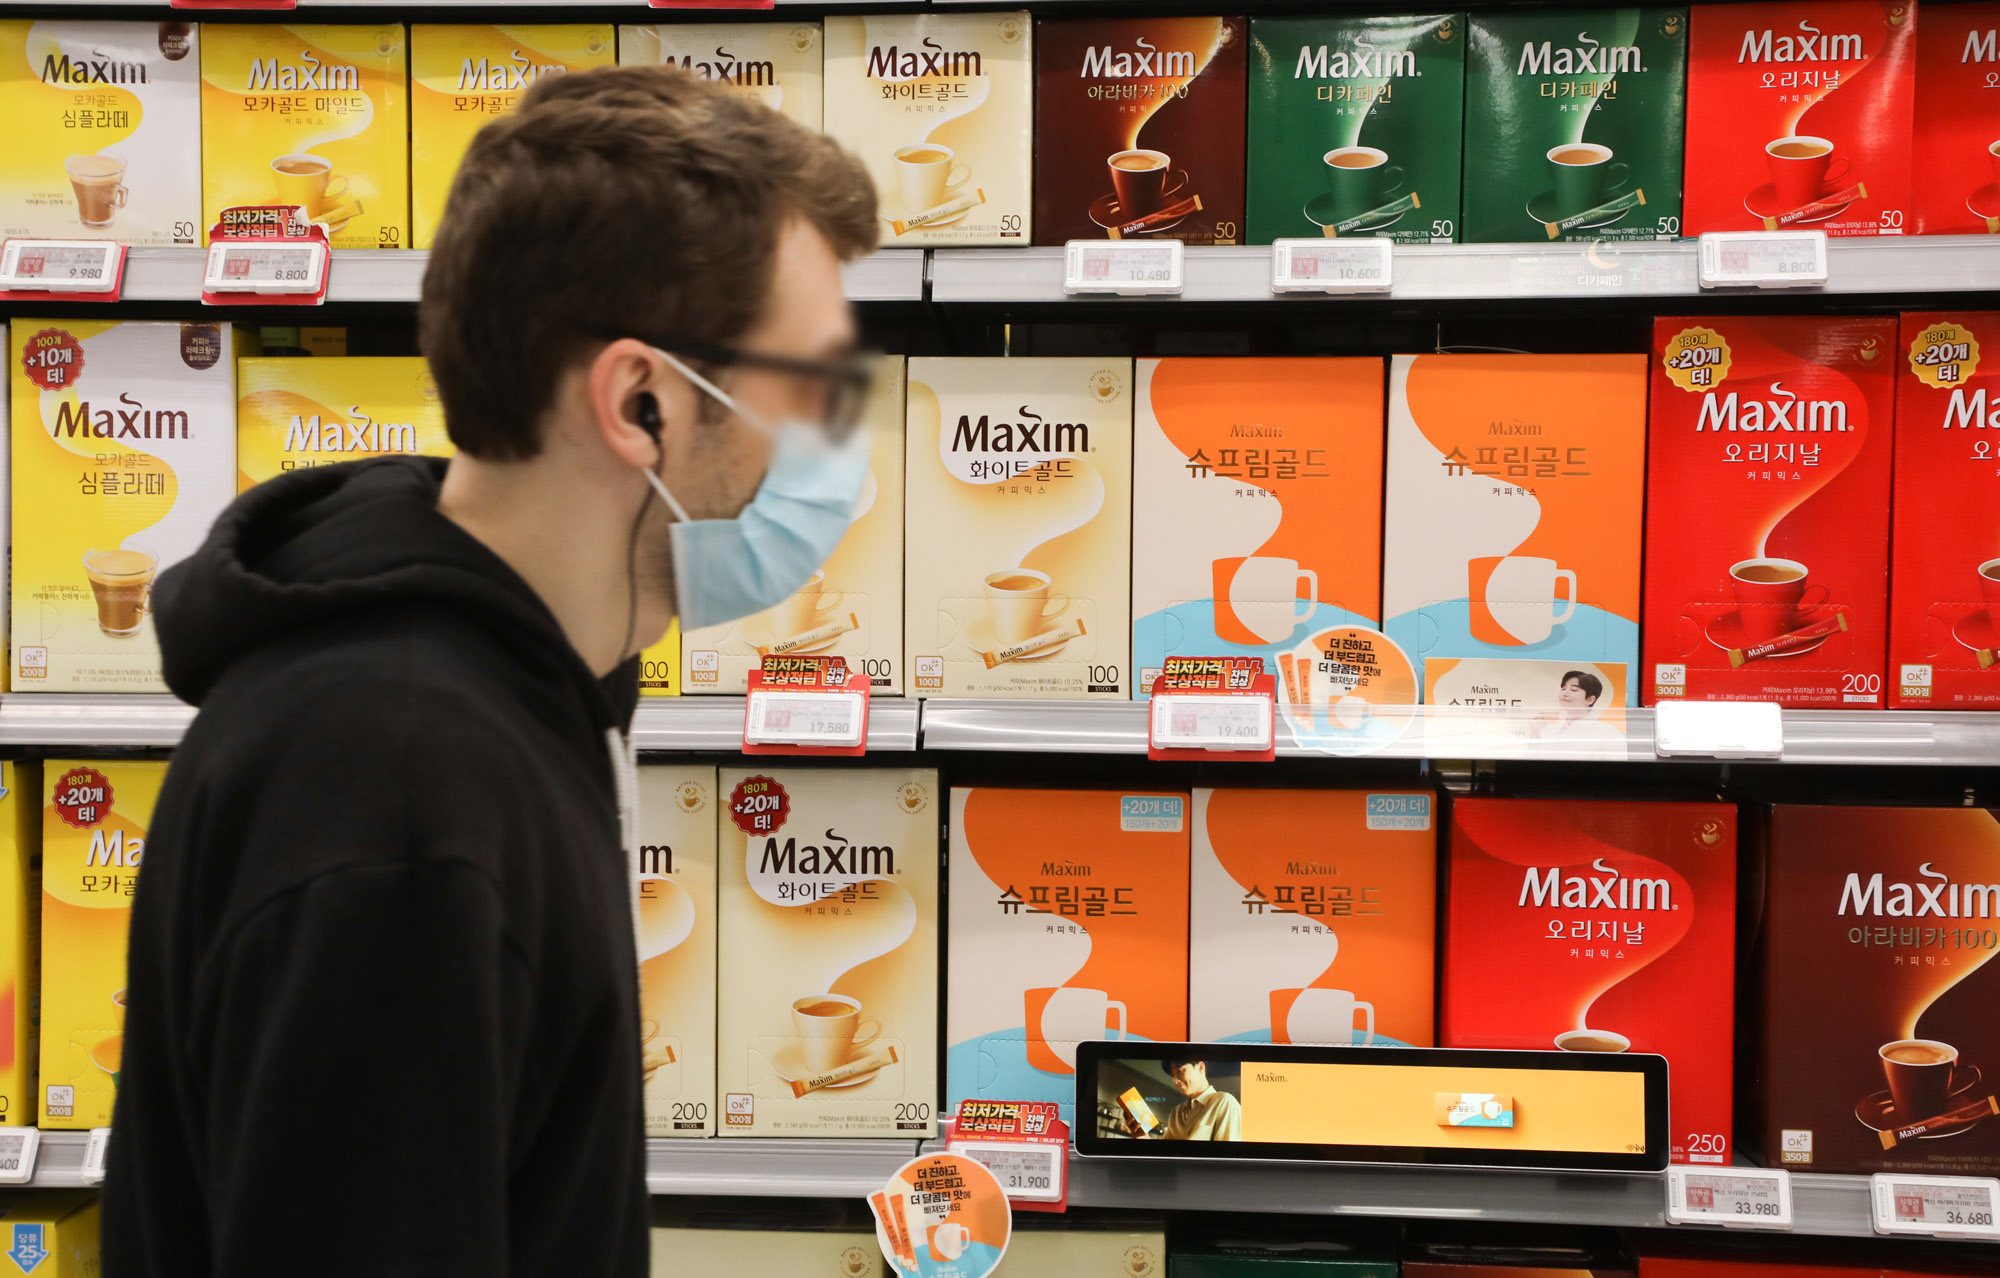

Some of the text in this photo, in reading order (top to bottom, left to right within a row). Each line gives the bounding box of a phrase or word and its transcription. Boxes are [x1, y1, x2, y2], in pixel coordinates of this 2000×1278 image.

[1738, 20, 1862, 62] Maxim
[867, 37, 981, 77] Maxim
[1081, 37, 1195, 77] Maxim
[1294, 36, 1416, 79] Maxim
[1517, 32, 1641, 75] Maxim
[42, 49, 147, 84] Maxim
[248, 51, 358, 90] Maxim
[1760, 70, 1841, 89] 오리지날
[882, 84, 968, 101] 화이트골드
[1317, 84, 1392, 104] 디카페인
[1541, 80, 1617, 99] 디카페인
[74, 95, 118, 107] 모카골드
[1780, 94, 1824, 102] 커피믹스
[243, 97, 365, 115] 모카골드 마일드
[62, 110, 129, 128] 심플라떼
[223, 209, 279, 224] 최저가격
[1001, 215, 1021, 231] 50
[1561, 217, 1584, 230] Maxim
[1780, 210, 1804, 224] Maxim
[1880, 210, 1903, 227] 50
[173, 222, 194, 237] 50
[223, 224, 278, 238] 보상적립
[1123, 221, 1145, 234] Maxim
[1215, 222, 1236, 239] 50
[1338, 219, 1361, 232] Maxim
[1431, 220, 1453, 237] 50
[1657, 217, 1679, 234] 50
[379, 227, 399, 242] 50
[69, 268, 102, 279] 9.980
[275, 269, 308, 280] 8.800
[1131, 270, 1170, 281] 10.480
[1339, 268, 1380, 279] 10.600
[1578, 275, 1622, 287] 디카페인
[36, 336, 61, 347] 100개
[1679, 334, 1708, 346] 180개
[1926, 330, 1955, 342] 180개
[27, 348, 73, 367] +10개
[1670, 348, 1720, 369] +20개
[1915, 343, 1969, 365] +20개
[47, 368, 64, 384] 더!
[1691, 369, 1710, 386] 더!
[1938, 365, 1958, 381] 더!
[1696, 382, 1846, 432] Maxim
[54, 392, 188, 439] Maxim
[284, 406, 416, 452] Maxim
[952, 405, 1089, 452] Maxim
[1230, 422, 1282, 438] Maxim
[1488, 418, 1542, 436] Maxim
[95, 453, 151, 468] 모카골드
[1442, 446, 1591, 478] 슈프림골드
[1722, 443, 1821, 466] 오리지날
[970, 460, 1074, 481] 화이트골드
[1186, 448, 1330, 480] 슈프림골드
[1747, 471, 1801, 480] 커피믹스
[78, 472, 165, 495] 심플라떼
[997, 486, 1046, 494] 커피믹스
[1235, 488, 1278, 498] 커피믹스
[1493, 488, 1537, 496] 커피믹스
[774, 640, 797, 654] Maxim
[1000, 646, 1024, 660] Maxim
[1330, 639, 1374, 652] 더 진하고,
[1748, 643, 1774, 658] Maxim
[763, 658, 819, 671] 최저가격
[1324, 651, 1378, 664] 더 부드럽고,
[640, 662, 668, 679] 100
[861, 660, 891, 676] 100
[1165, 659, 1222, 674] 최저가격
[1318, 662, 1382, 677] 더 달콤한 맛에
[694, 672, 716, 681] 100점
[761, 671, 817, 686] 보상적립
[826, 675, 844, 684] 보상
[1088, 666, 1119, 683] 100
[1163, 674, 1220, 689] 보상적립
[1330, 676, 1369, 686] 빠져보세요
[918, 678, 940, 687] 100점
[1229, 678, 1248, 687] 보상
[1471, 685, 1499, 694] Maxim
[1842, 674, 1880, 692] 200
[1658, 686, 1683, 696] 300점
[1903, 688, 1929, 697] 300점
[810, 722, 849, 734] 17.580
[1217, 725, 1258, 737] 19.400
[67, 775, 92, 785] 180개
[743, 783, 768, 794] 180개
[58, 787, 104, 806] +20개
[734, 795, 779, 815] +20개
[1123, 801, 1178, 815] +20개 더!
[1369, 799, 1425, 813] +20개 더!
[78, 807, 95, 821] 더!
[754, 815, 771, 830] 더!
[760, 828, 894, 874] Maxim
[1041, 860, 1091, 877] Maxim
[1286, 859, 1337, 876] Maxim
[1518, 858, 1671, 910] Maxim
[1838, 863, 2000, 918] Maxim
[777, 881, 879, 903] 화이트골드
[998, 885, 1137, 916] 슈프림골드
[1242, 885, 1384, 916] 슈프림골드
[804, 906, 853, 916] 커피믹스
[1046, 926, 1087, 934] 커피믹스
[1291, 926, 1333, 934] 커피믹스
[1545, 920, 1646, 945] 오리지날
[1570, 948, 1625, 959] 커피믹스
[1894, 956, 1951, 966] 커피믹스
[809, 1075, 833, 1088] Maxim
[1256, 1072, 1286, 1083] Maxim
[672, 1103, 707, 1120] 200
[731, 1101, 745, 1110] OK
[894, 1103, 929, 1121] 200
[962, 1102, 1019, 1118] 최저가격
[728, 1115, 750, 1124] 300점
[960, 1118, 1016, 1133] 보상적립
[1027, 1115, 1045, 1123] 차액
[1025, 1123, 1043, 1132] 보상
[1900, 1125, 1926, 1139] Maxim
[1687, 1134, 1725, 1153] 250
[1788, 1138, 1803, 1146] OK
[1785, 1153, 1809, 1162] 350점
[917, 1166, 960, 1178] 더 진하고,
[914, 1178, 966, 1191] 더 부드럽고,
[1009, 1176, 1049, 1188] 31.900
[911, 1190, 971, 1204] 더 달콤한 맛에
[924, 1203, 961, 1214] 빠져보세요
[1735, 1202, 1779, 1216] 33.980
[1946, 1211, 1992, 1225] 36.680
[18, 1233, 37, 1243] 당류
